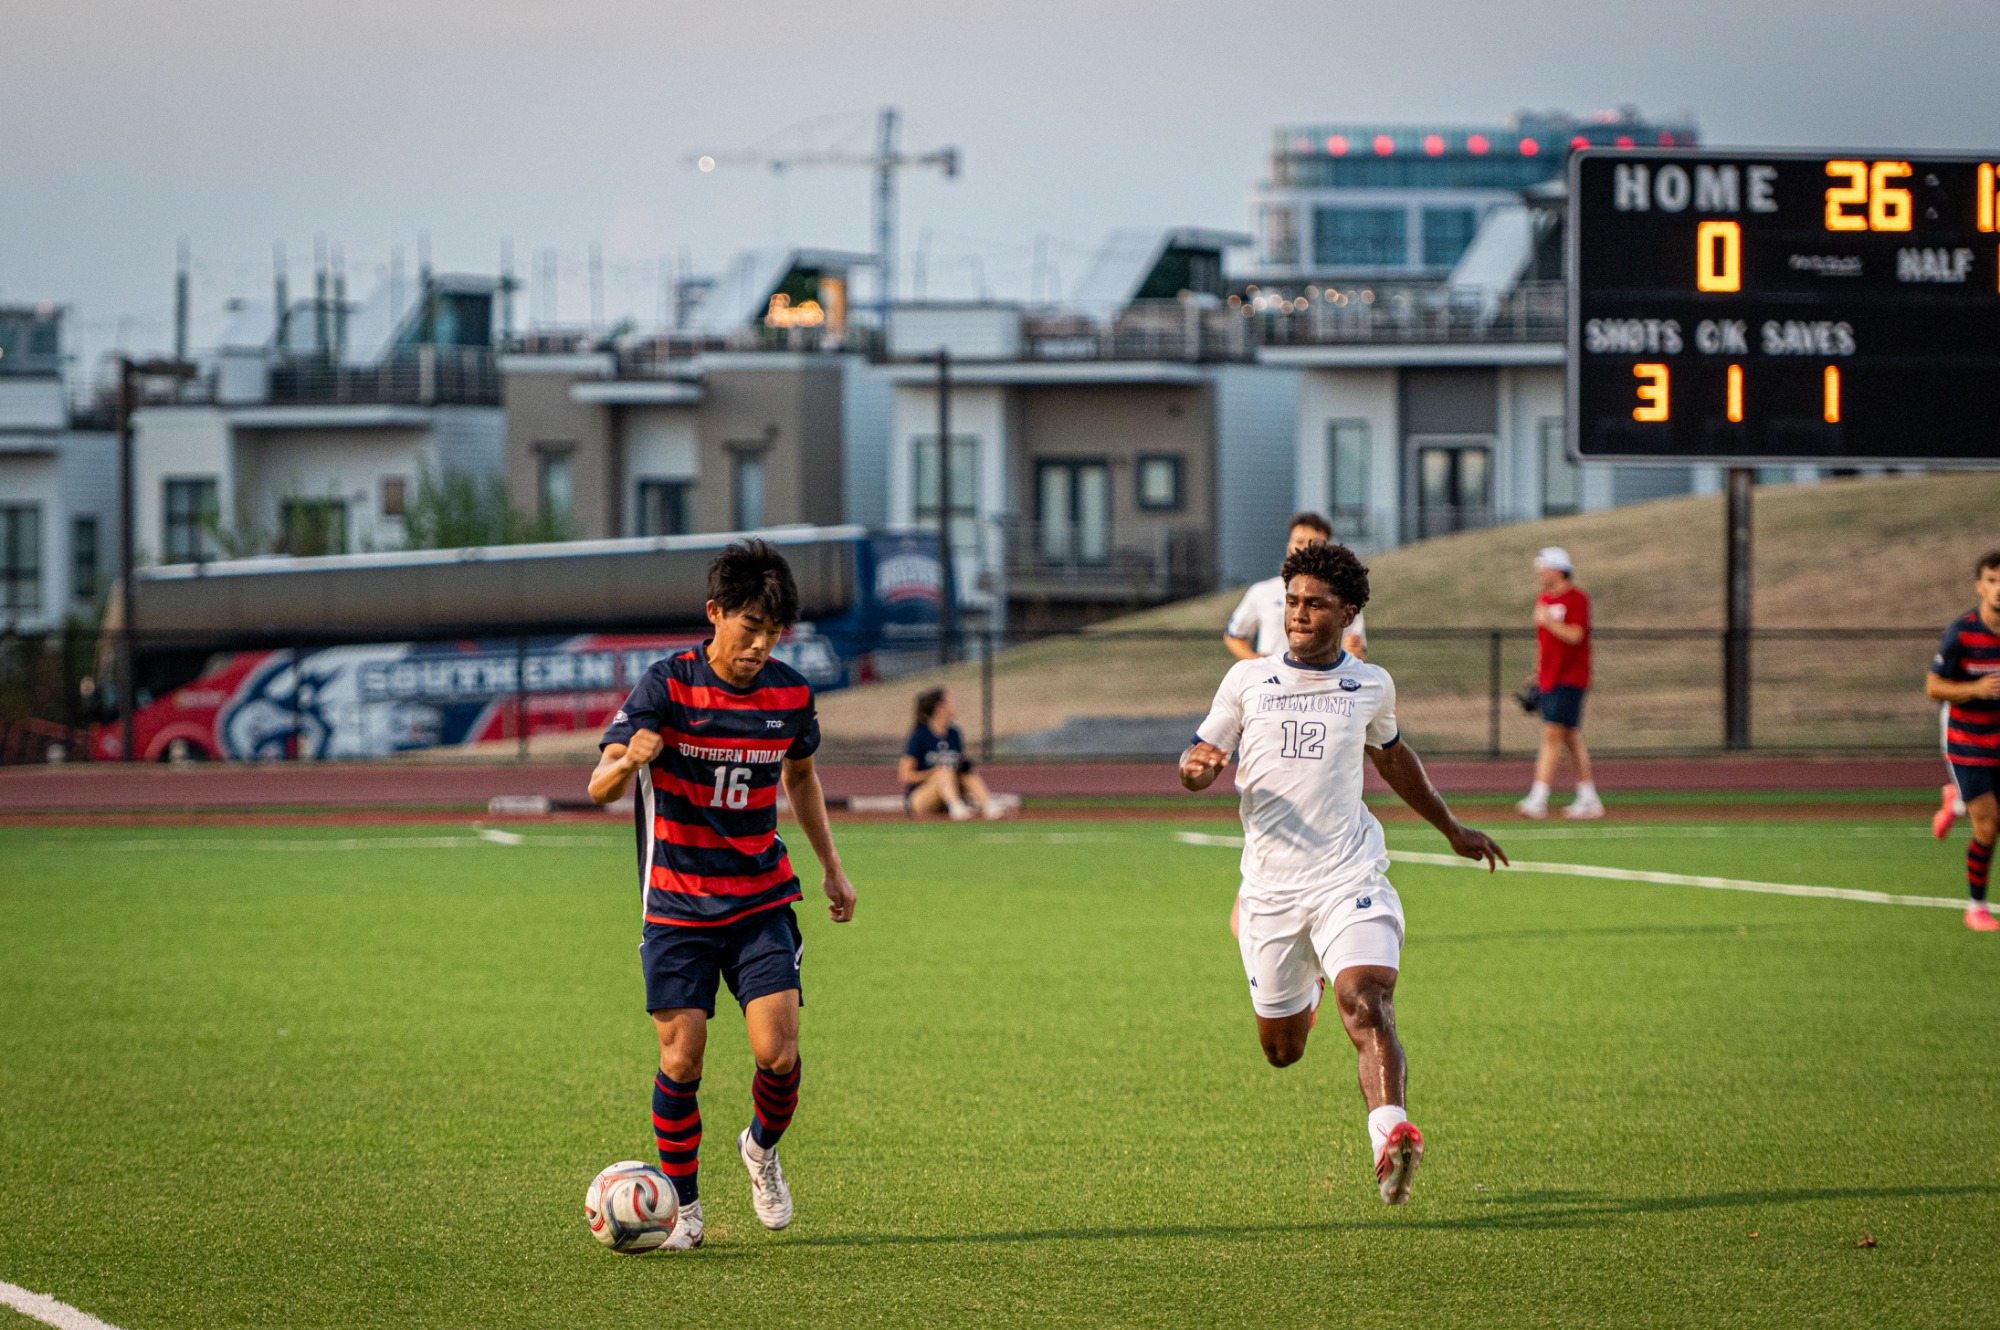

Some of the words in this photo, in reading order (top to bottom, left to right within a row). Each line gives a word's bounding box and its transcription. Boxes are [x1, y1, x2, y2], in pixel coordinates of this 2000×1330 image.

[1614, 165, 1778, 213] HOME
[1825, 160, 1913, 231] 26
[1977, 162, 2000, 232] 1
[1697, 220, 1741, 292] 0
[1897, 247, 1975, 282] HALF
[1585, 318, 1684, 355] SHOTS
[1761, 319, 1856, 356] SAVES
[1633, 363, 1670, 422] 3
[1727, 364, 1744, 423] 1
[1824, 365, 1841, 423] 1
[361, 652, 614, 694] SOUTHERN
[766, 720, 782, 728] TCG
[1257, 694, 1355, 717] BELMONT
[1281, 720, 1326, 760] 12
[710, 766, 752, 809] 16
